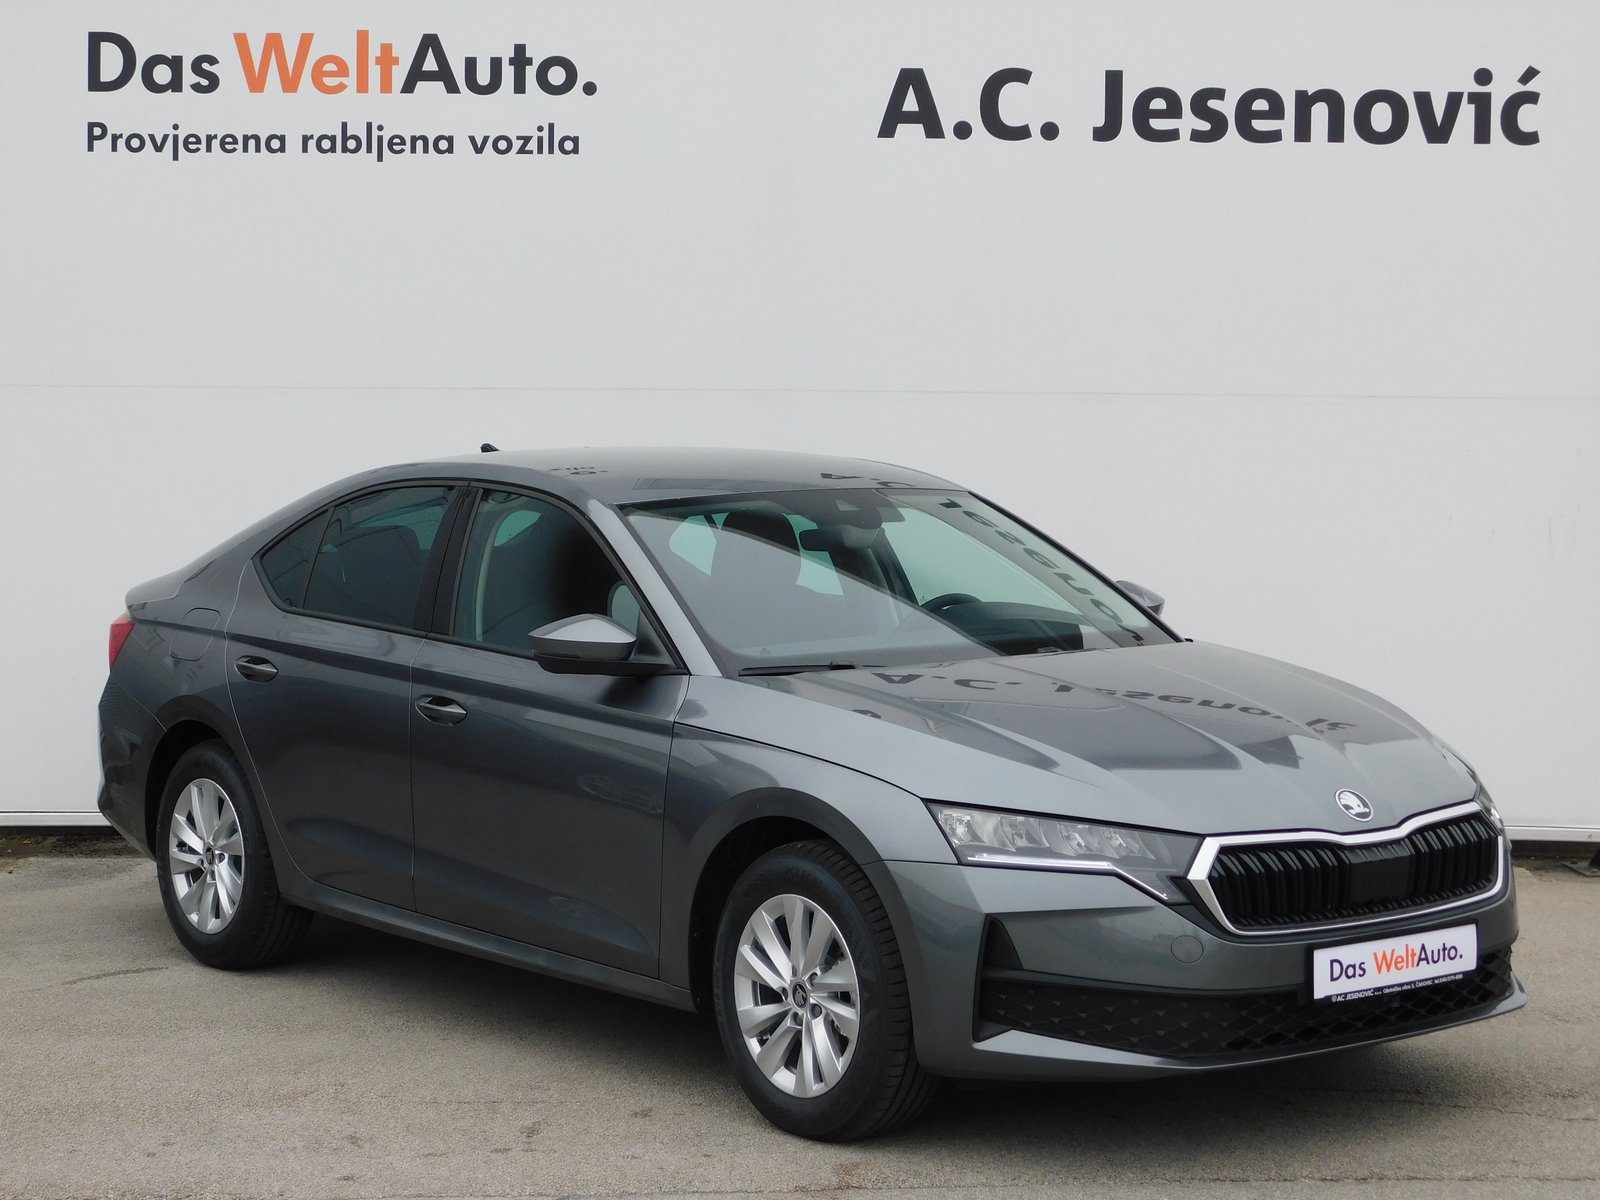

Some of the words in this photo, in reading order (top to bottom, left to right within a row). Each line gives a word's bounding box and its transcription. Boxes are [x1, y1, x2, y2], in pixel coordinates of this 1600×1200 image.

[88, 31, 220, 94] Das
[233, 30, 597, 96] WeltAuto.
[876, 67, 1060, 142] A.C.
[1092, 65, 1541, 146] Jesenović
[87, 122, 286, 161] Provjerena
[301, 121, 454, 162] rabljena
[468, 122, 580, 155] vozila
[1329, 958, 1367, 982] Das
[1373, 942, 1463, 974] WeltAuto.
